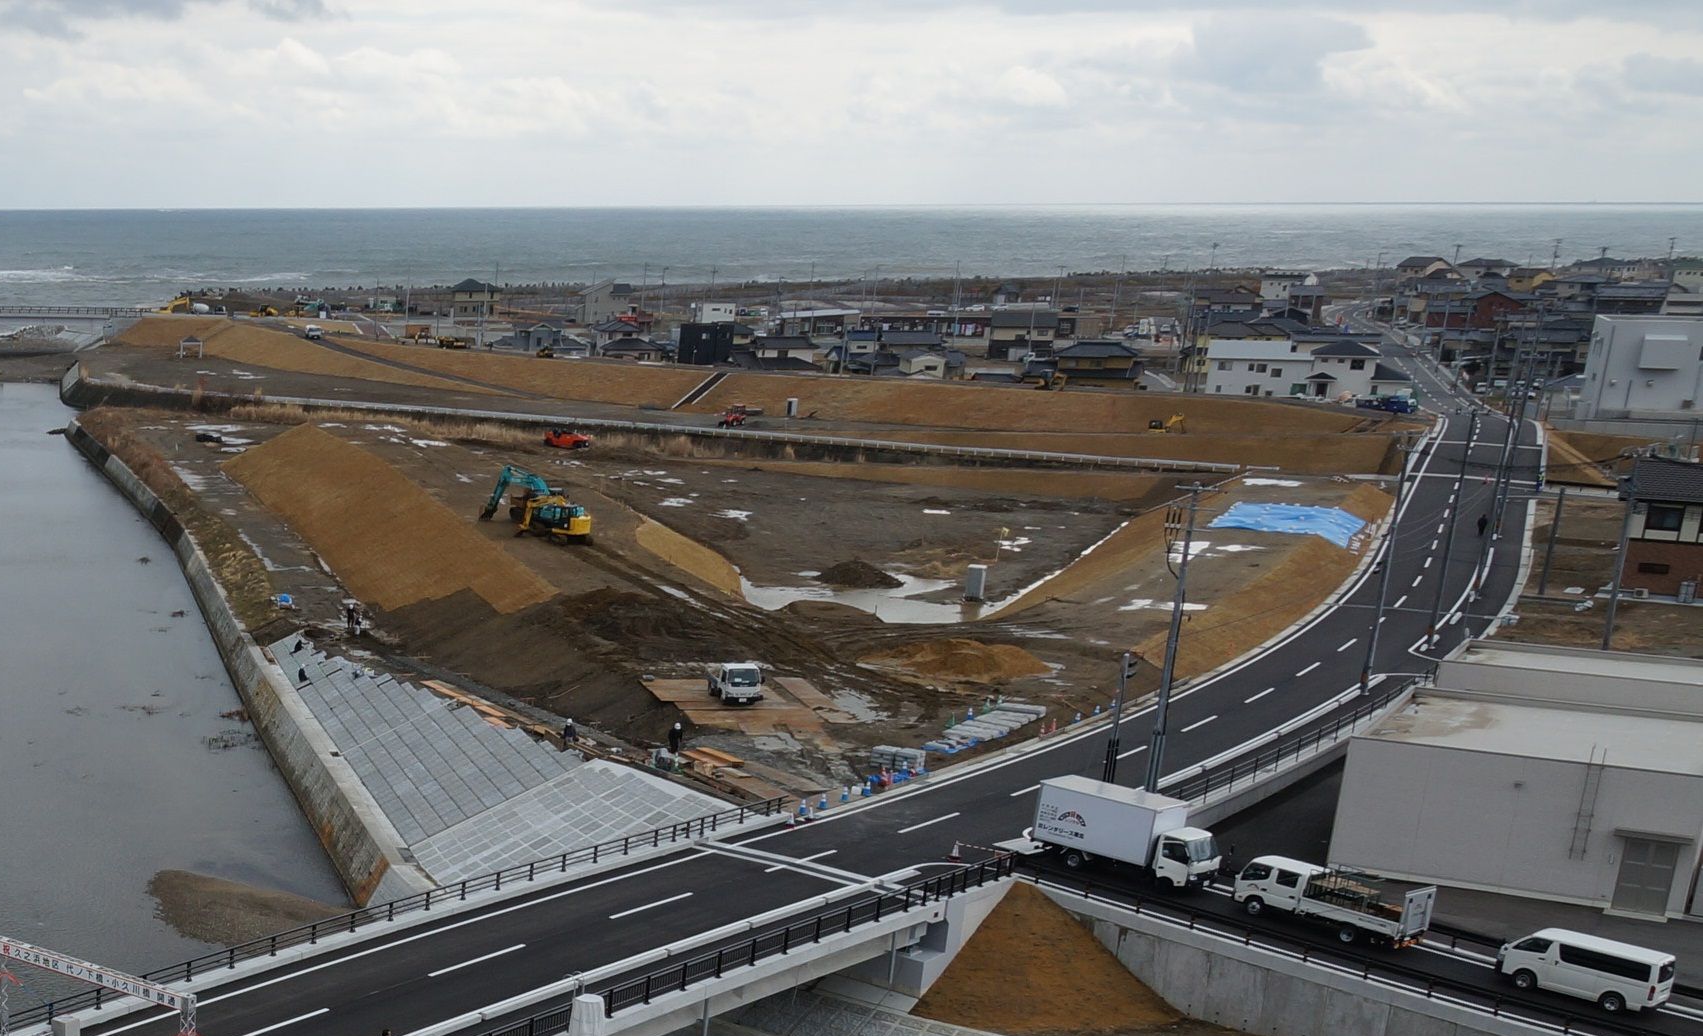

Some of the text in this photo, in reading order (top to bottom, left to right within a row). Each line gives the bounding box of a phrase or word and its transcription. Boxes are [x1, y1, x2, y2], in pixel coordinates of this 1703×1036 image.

[3, 944, 11, 956] 祝
[14, 948, 60, 970] 久之浜地区
